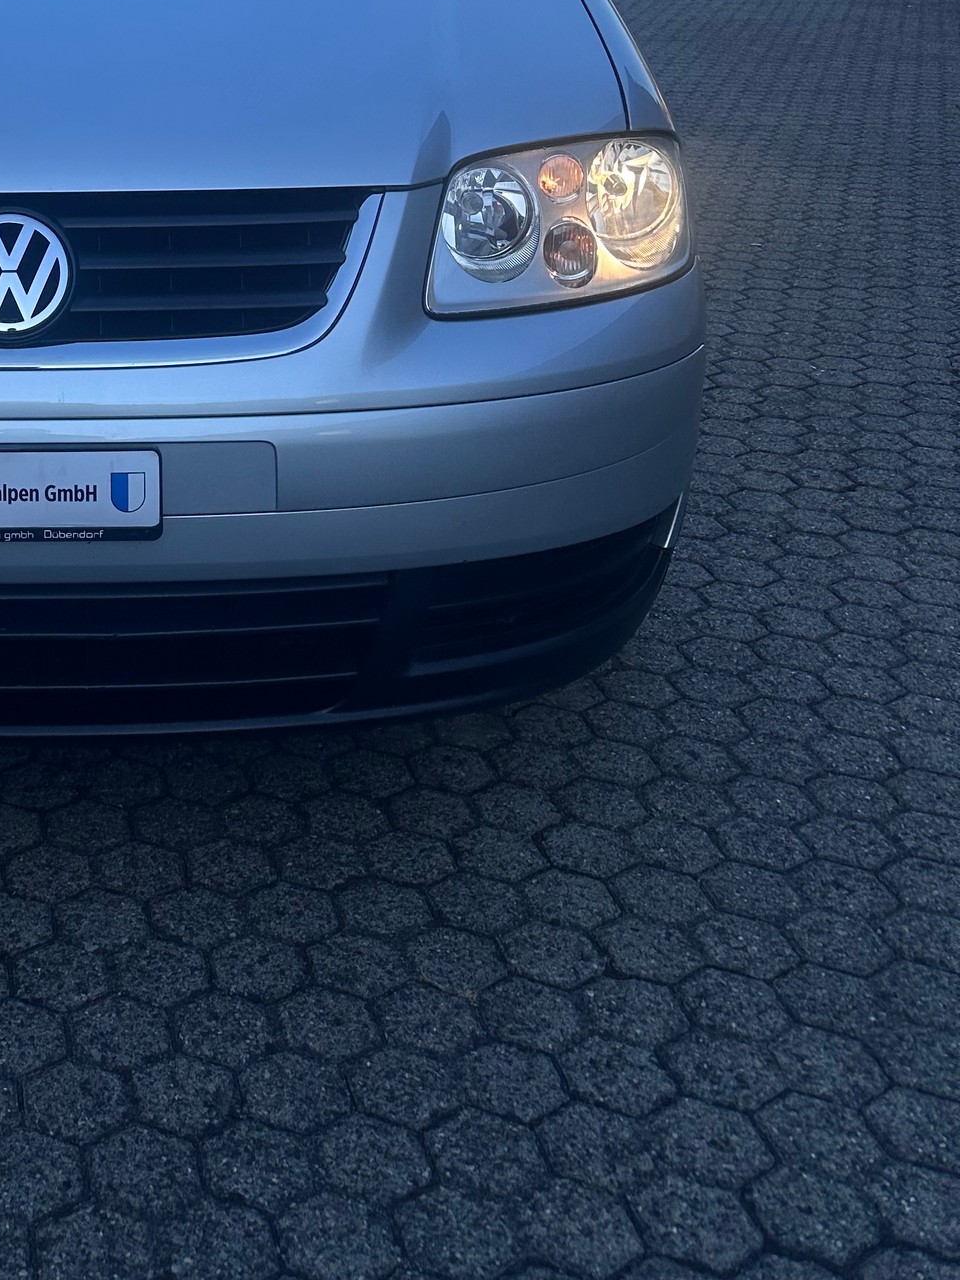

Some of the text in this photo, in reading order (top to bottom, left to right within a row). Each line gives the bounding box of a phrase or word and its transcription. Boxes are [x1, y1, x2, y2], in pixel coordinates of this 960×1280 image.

[44, 484, 98, 502] GmbH
[4, 530, 34, 541] gmbh
[43, 529, 104, 539] Dübendorf
